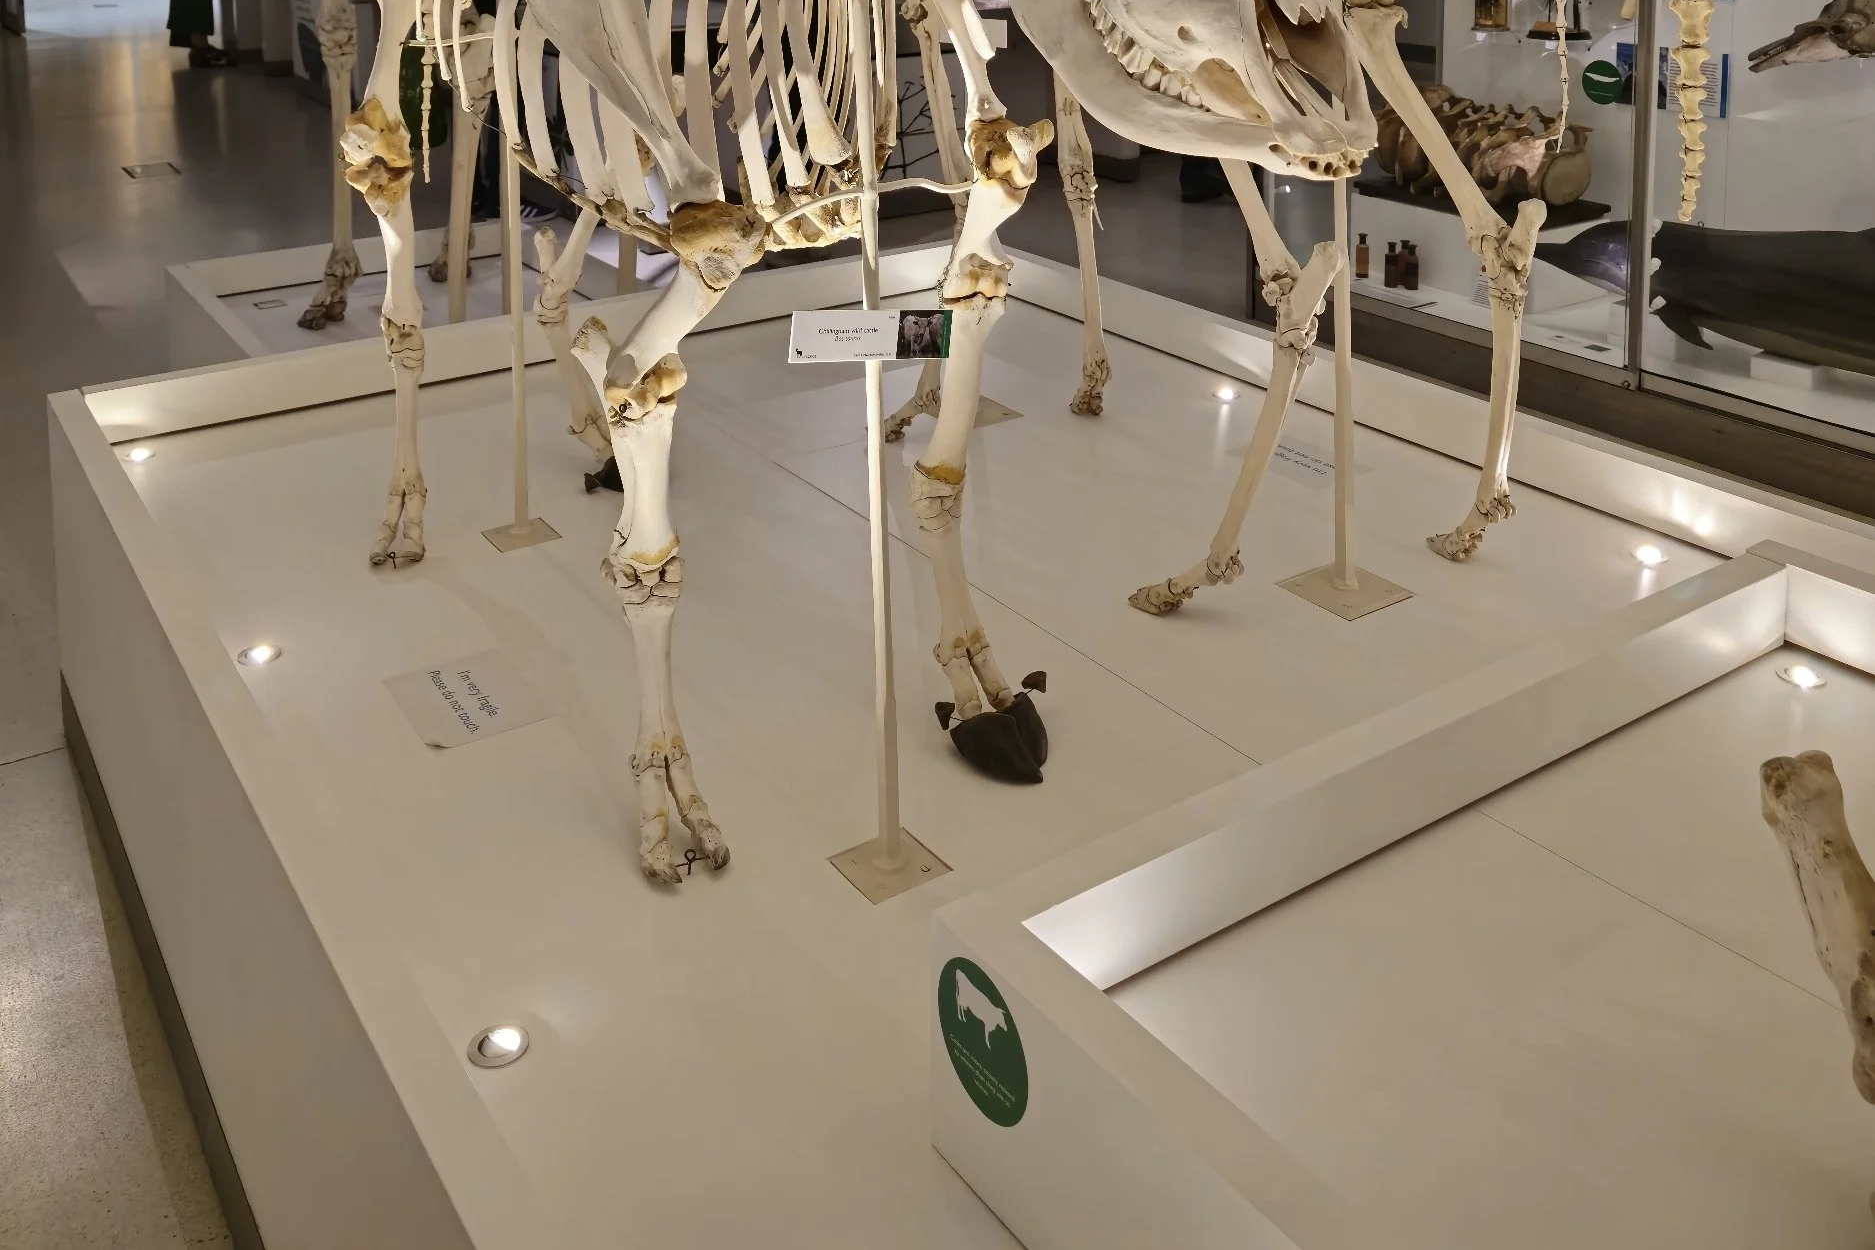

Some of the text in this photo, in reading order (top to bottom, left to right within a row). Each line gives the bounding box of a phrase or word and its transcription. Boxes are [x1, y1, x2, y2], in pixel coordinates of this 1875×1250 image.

[427, 670, 447, 690] Please
[442, 691, 455, 700] do
[449, 700, 464, 713] not
[467, 681, 482, 696] very
